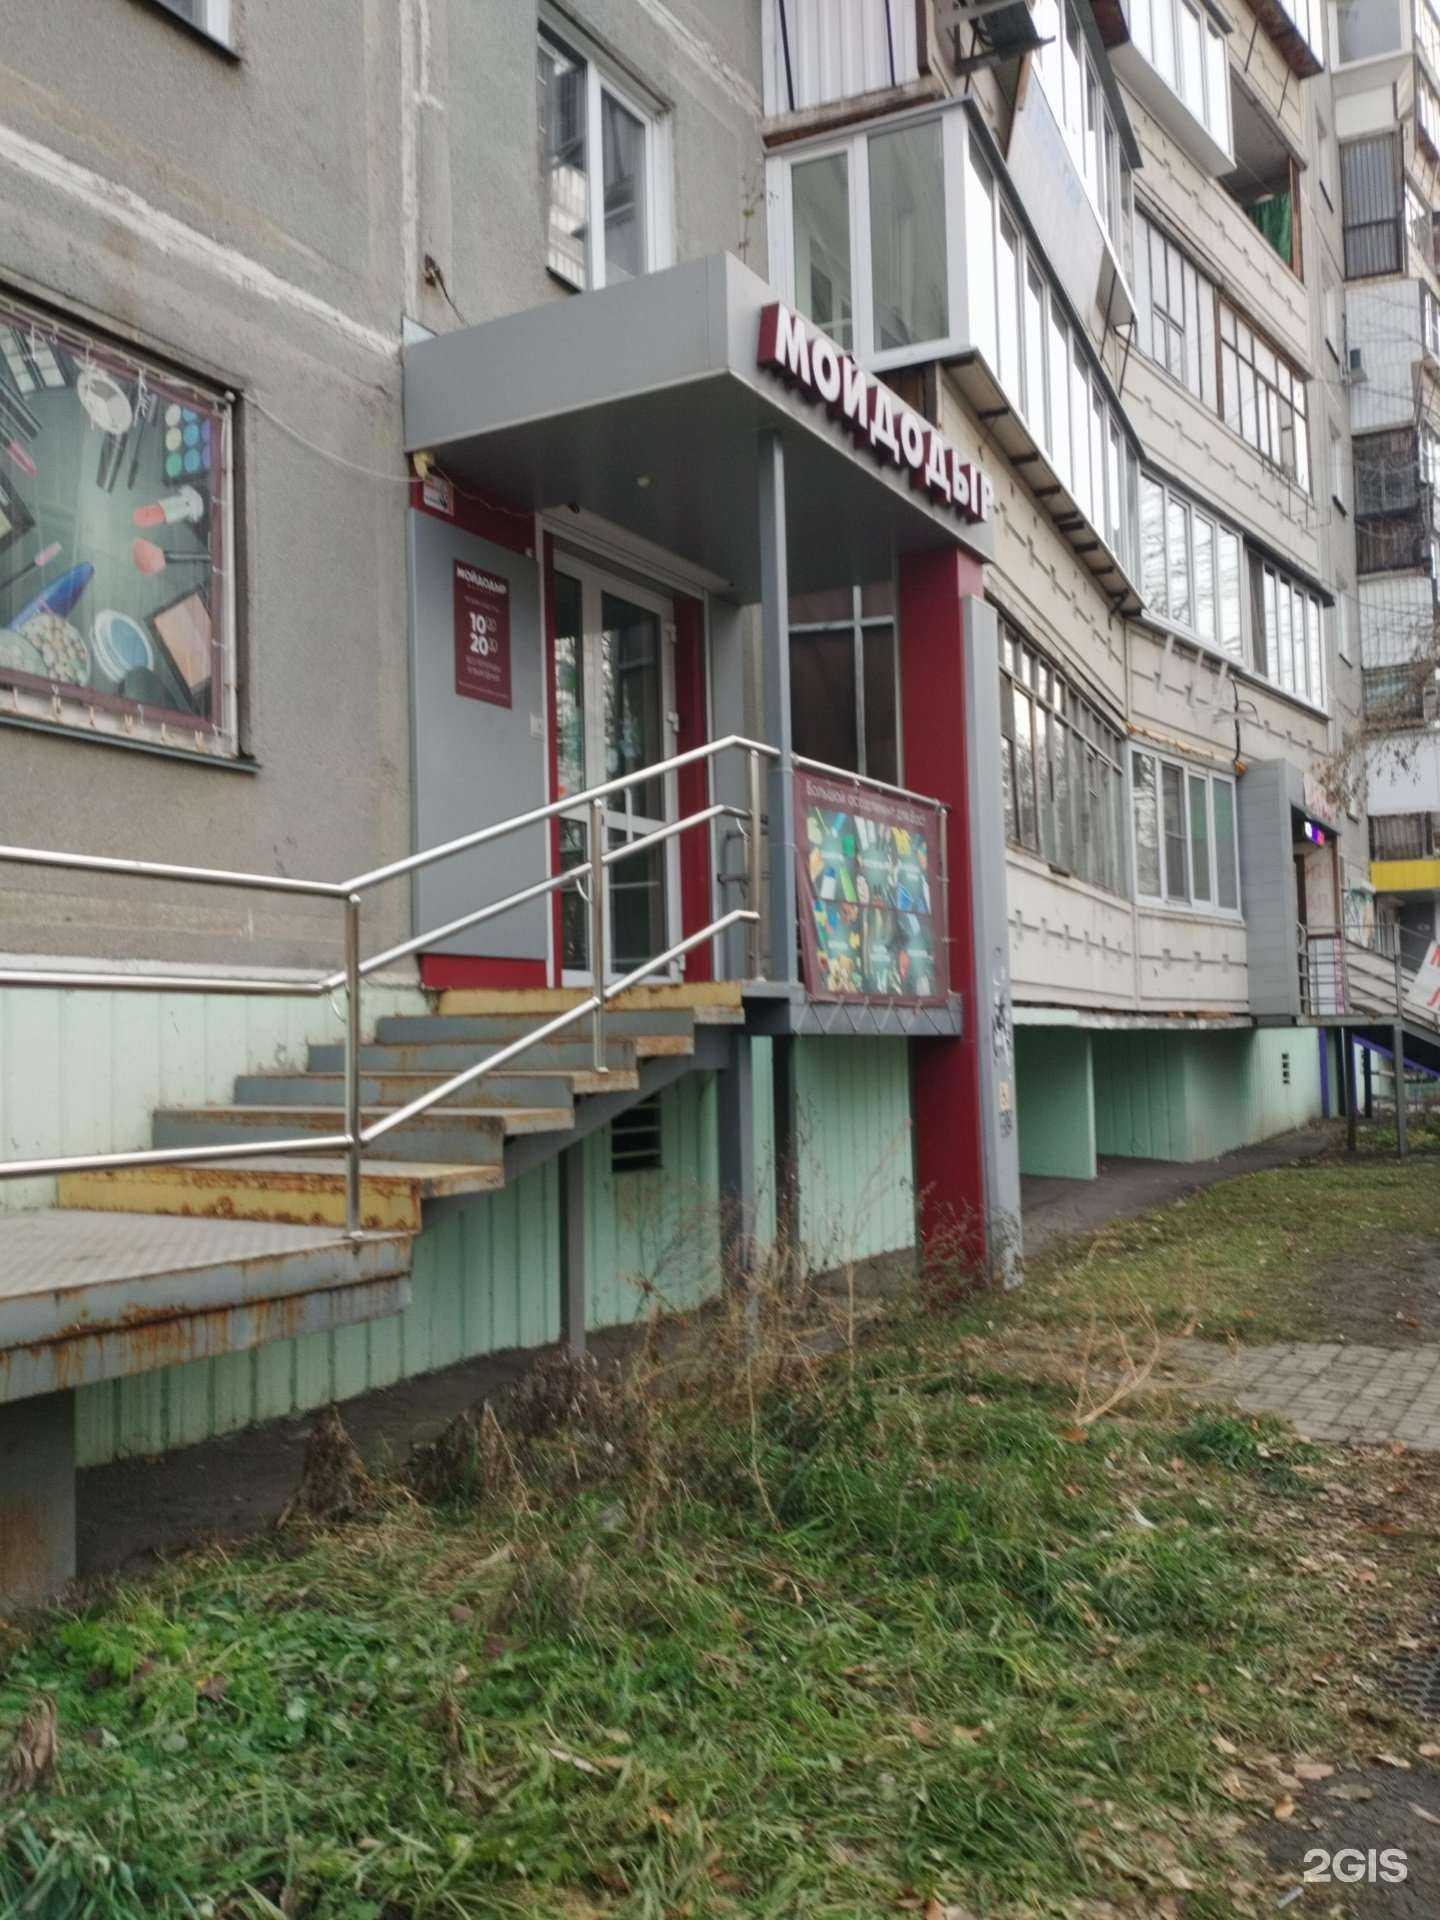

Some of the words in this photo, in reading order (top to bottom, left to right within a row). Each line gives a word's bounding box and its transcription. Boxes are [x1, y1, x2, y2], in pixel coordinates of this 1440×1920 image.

[772, 303, 994, 521] МОЙДОДЫР
[469, 612, 486, 634] 10
[470, 633, 489, 656] 20
